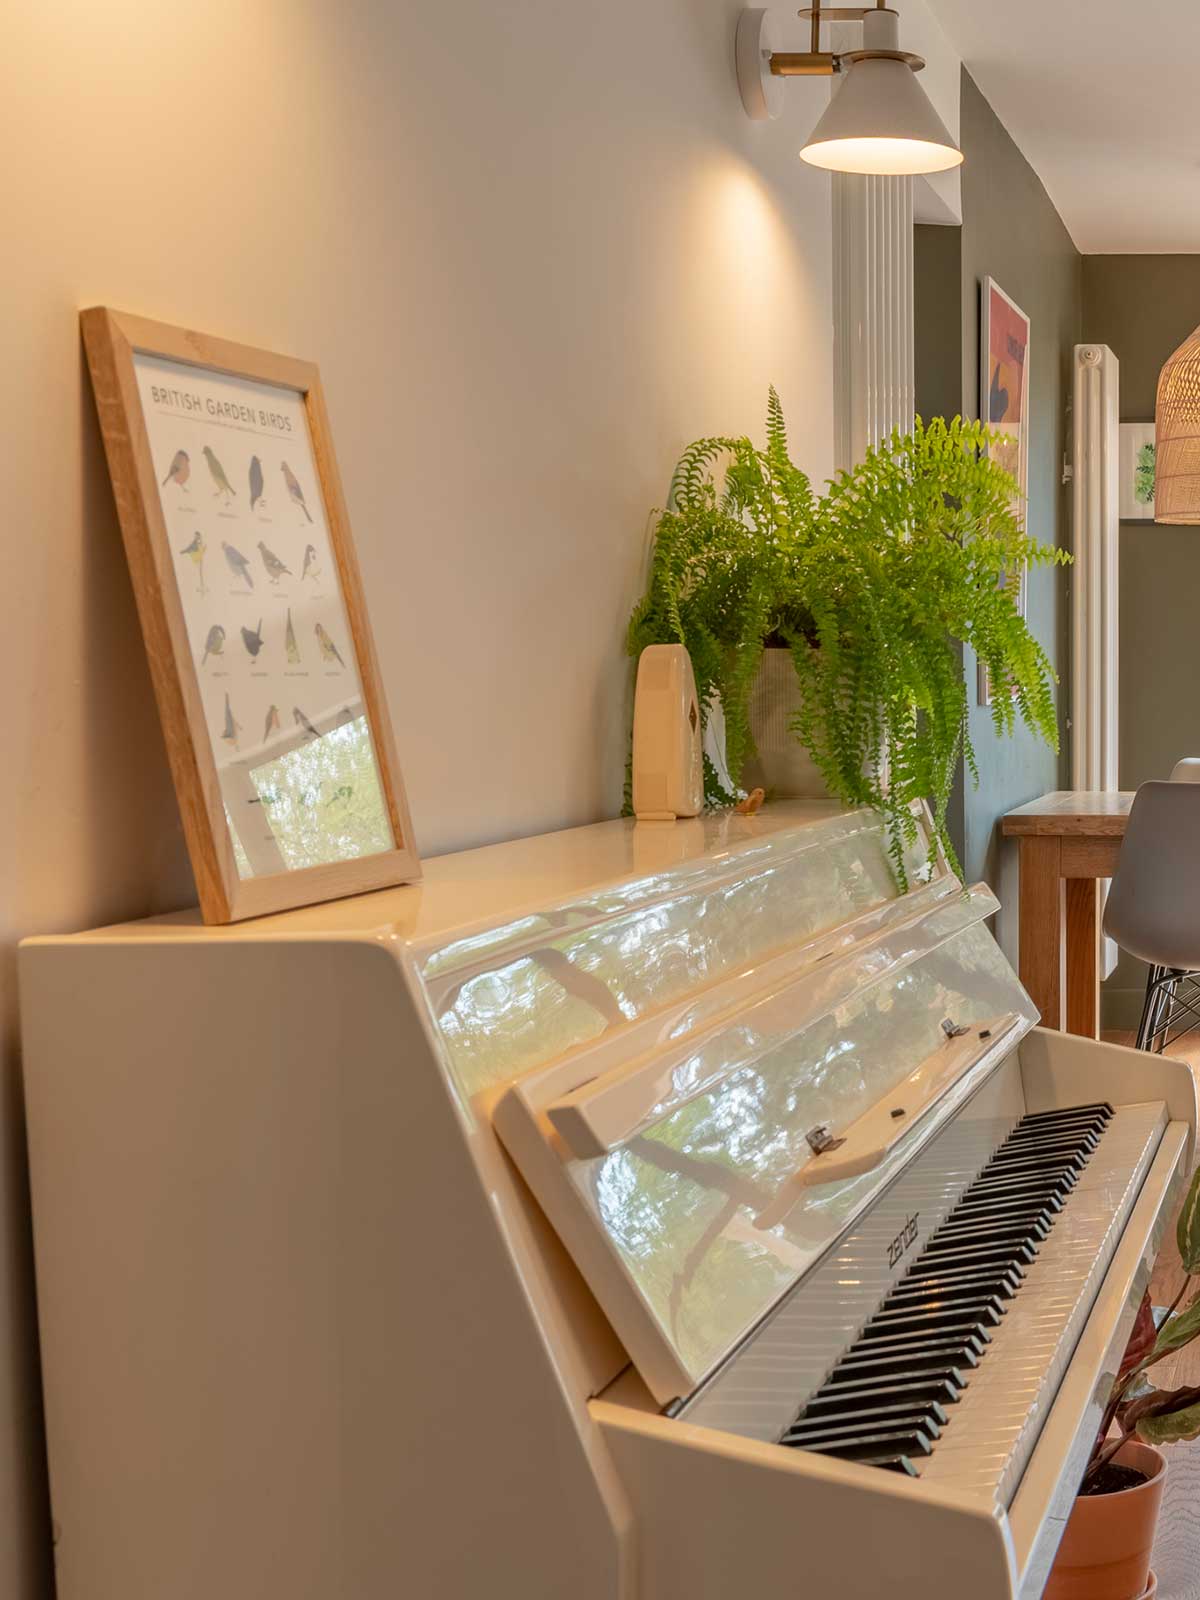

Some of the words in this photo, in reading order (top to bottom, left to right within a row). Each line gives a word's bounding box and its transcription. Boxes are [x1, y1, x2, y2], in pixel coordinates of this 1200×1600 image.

[151, 386, 201, 411] BRITISH
[206, 398, 256, 423] GARDEN
[258, 410, 292, 431] BIRDS
